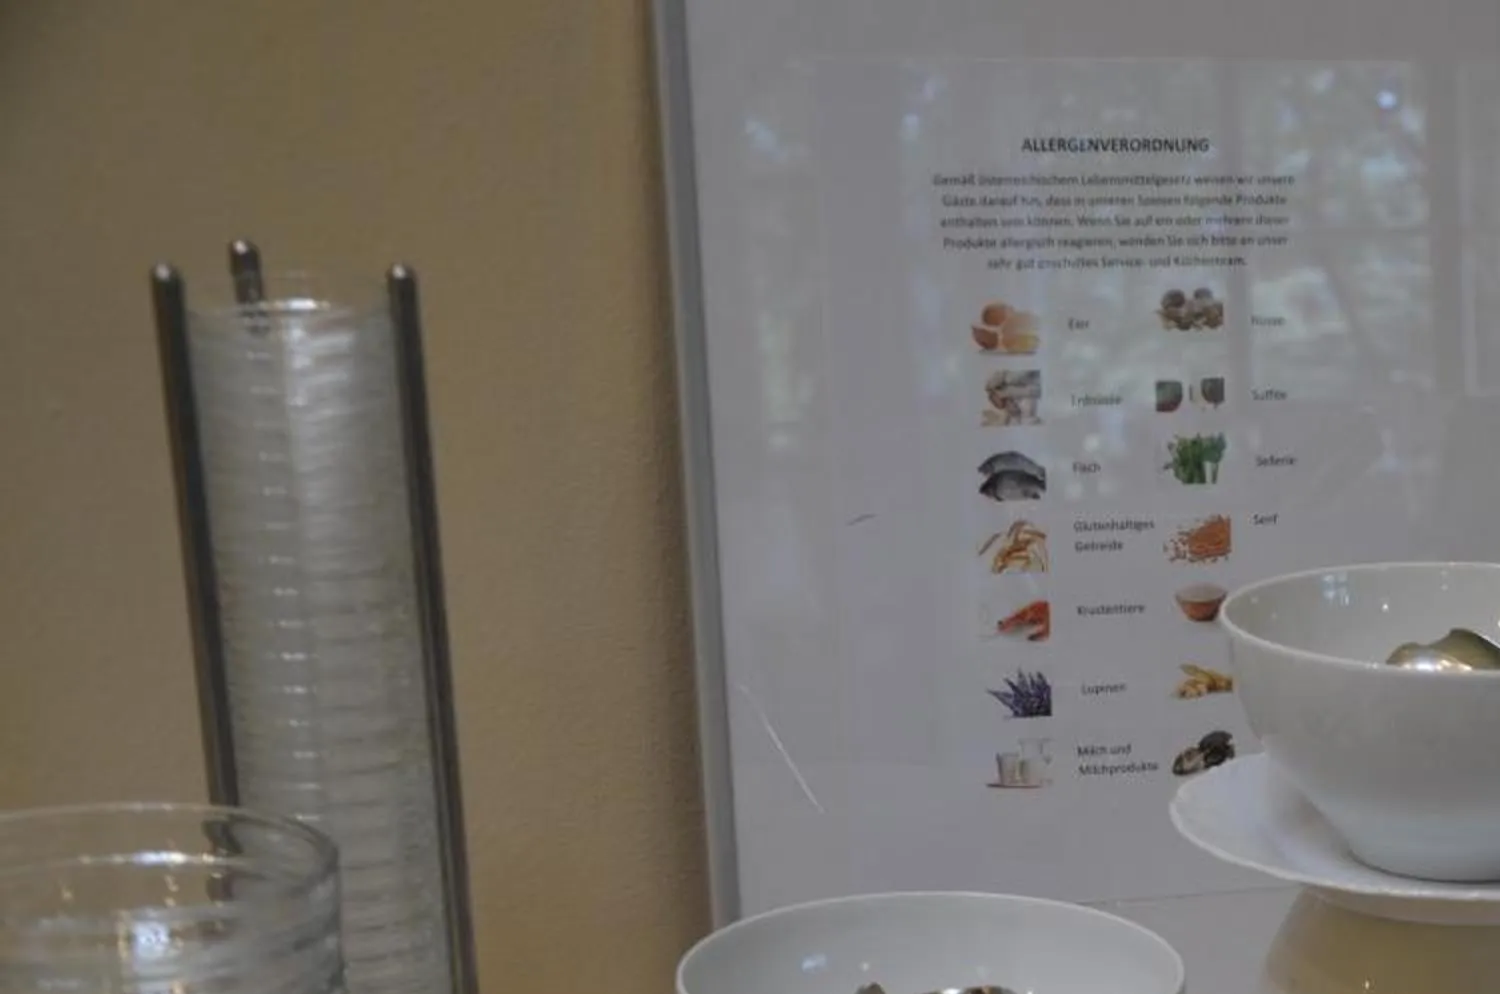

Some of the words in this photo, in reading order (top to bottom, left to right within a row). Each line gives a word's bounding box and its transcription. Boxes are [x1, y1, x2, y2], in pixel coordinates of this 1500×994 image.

[1021, 137, 1210, 153] ALLERGENVERORDNUNG
[1236, 194, 1288, 207] Produkte
[943, 236, 996, 249] Produkte
[1072, 461, 1102, 473] Fisch
[1077, 604, 1147, 616] Krustentiere
[1077, 745, 1108, 756] Milch
[1110, 743, 1132, 755] und
[1079, 761, 1160, 776] Milchprodukte
